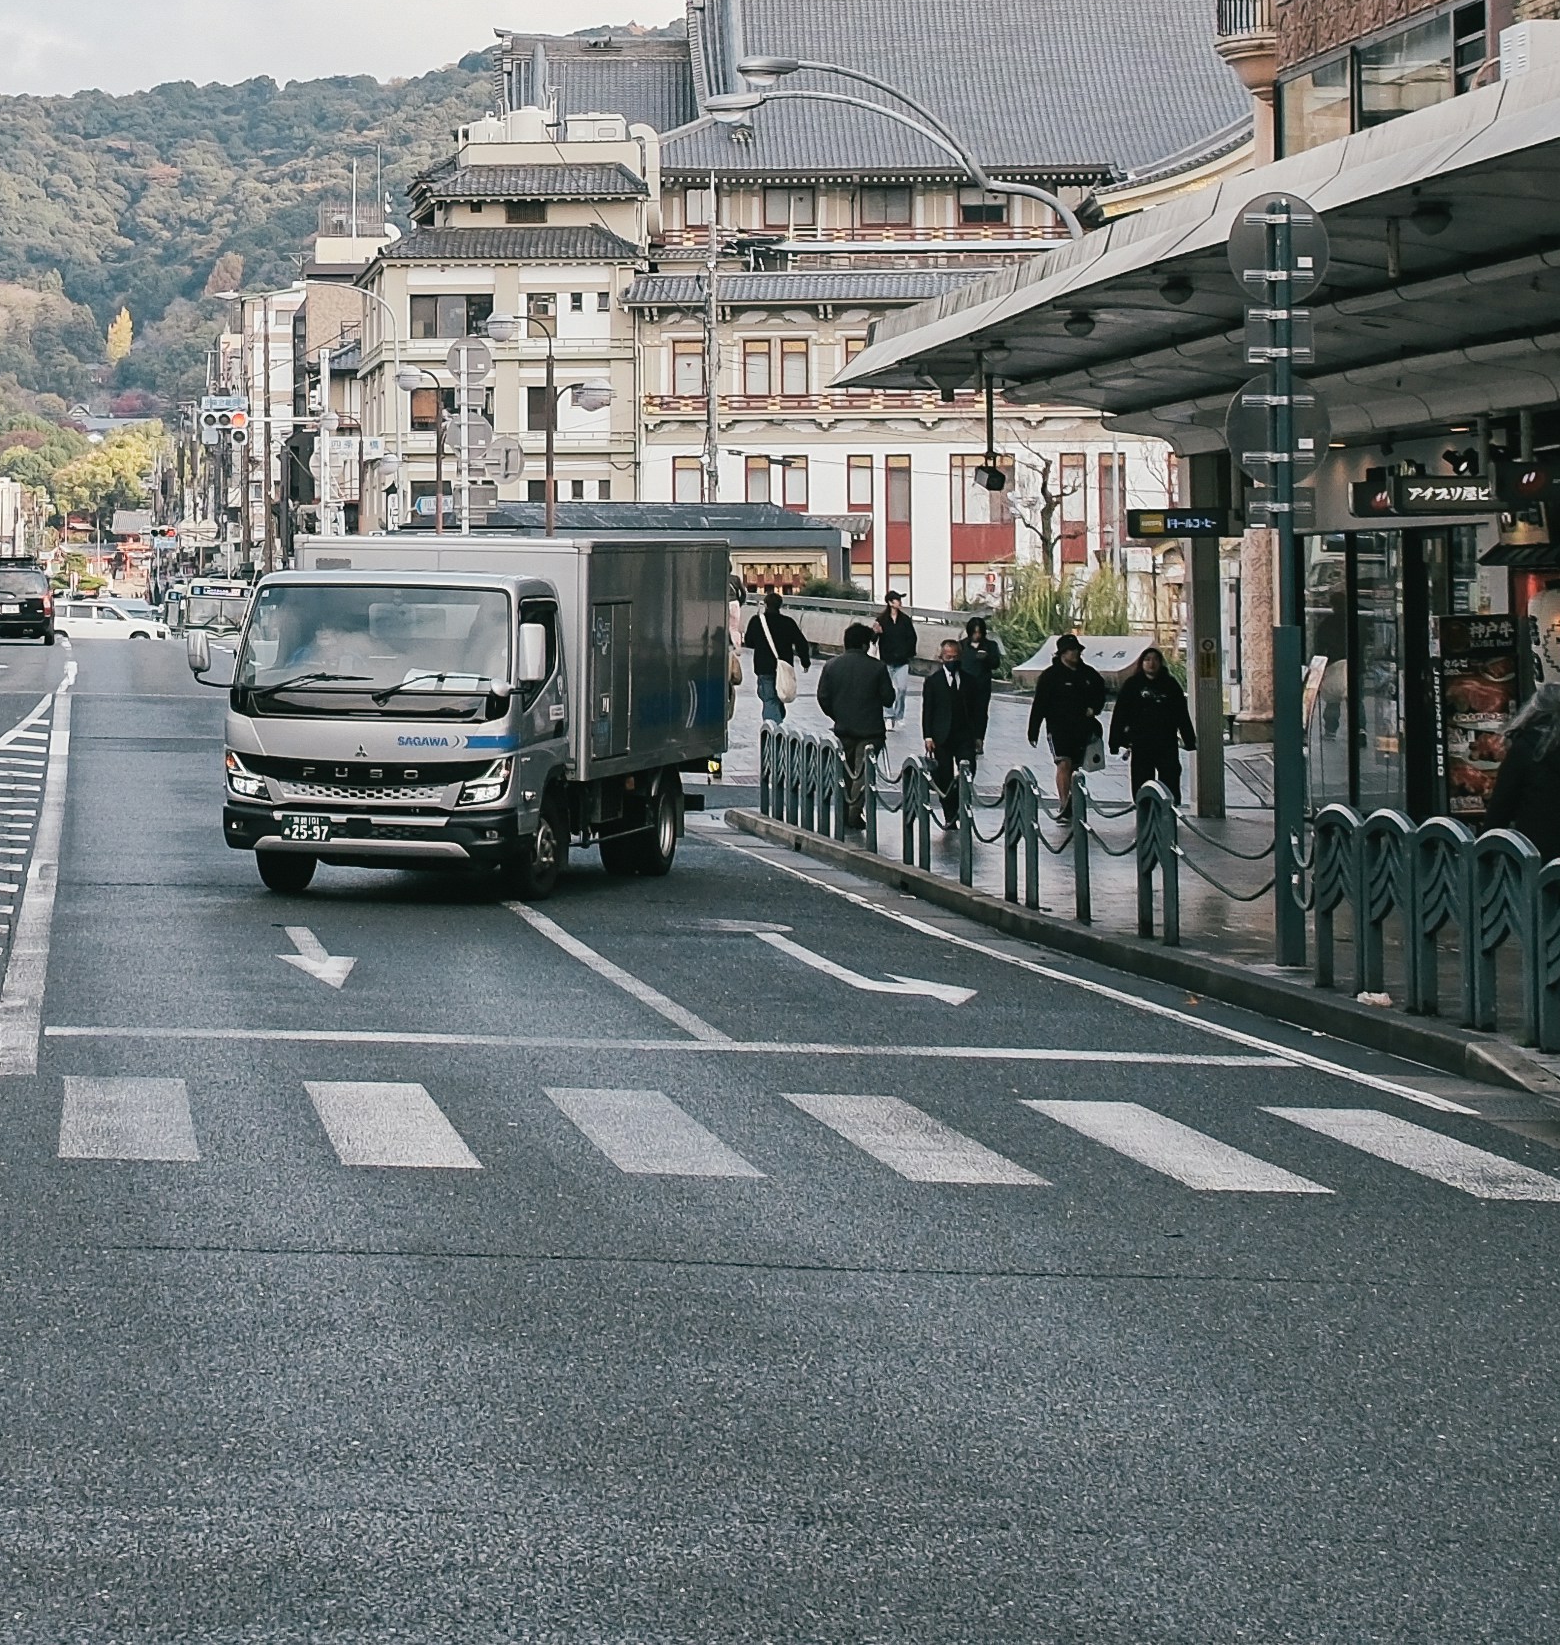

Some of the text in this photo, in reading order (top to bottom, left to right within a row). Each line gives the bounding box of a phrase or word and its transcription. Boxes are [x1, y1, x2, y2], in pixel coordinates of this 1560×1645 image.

[1469, 621, 1515, 638] 神戸牛
[397, 736, 449, 747] SAGAWA
[302, 766, 419, 780] FUSO
[291, 825, 329, 841] 25-97
